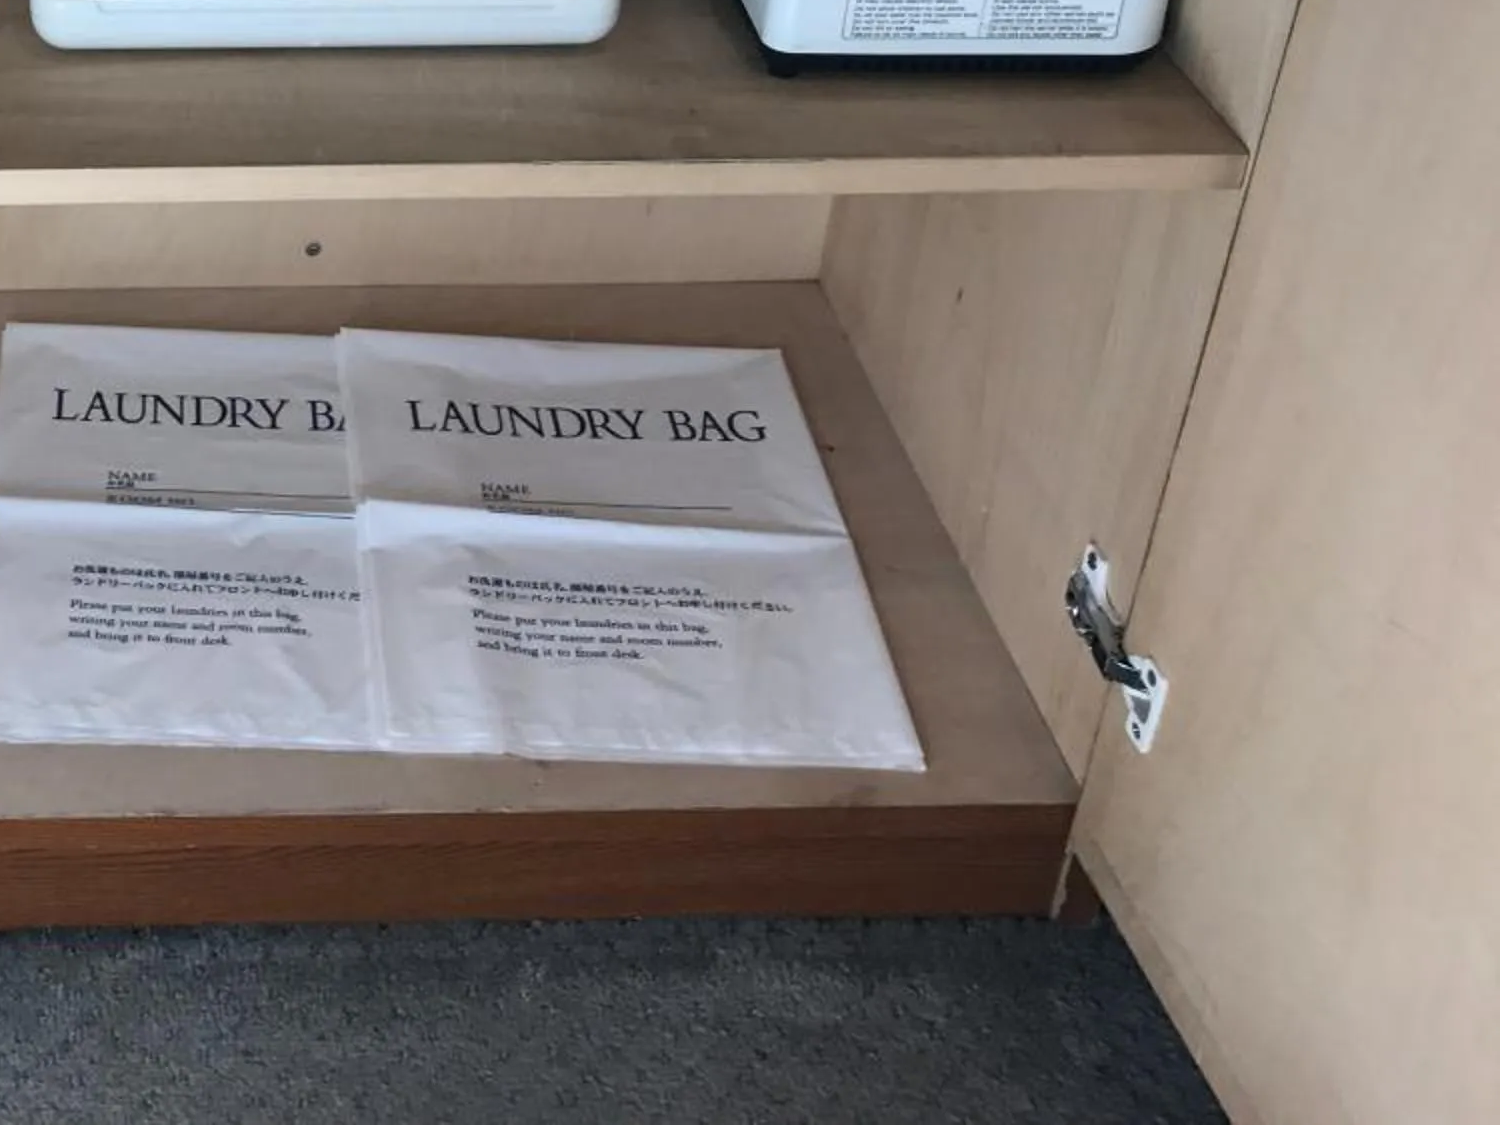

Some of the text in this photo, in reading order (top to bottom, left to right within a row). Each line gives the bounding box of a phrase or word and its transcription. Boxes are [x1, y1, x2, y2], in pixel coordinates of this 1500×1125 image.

[52, 388, 347, 432] LAUNDRY B
[405, 400, 767, 442] LAUNDRY BAG
[108, 470, 158, 482] NAME
[481, 482, 530, 494] NAME
[70, 598, 108, 610] Please
[112, 604, 132, 614] put
[138, 605, 166, 615] your
[69, 615, 116, 627] writing
[120, 619, 149, 629] your
[153, 621, 187, 630] name
[191, 621, 215, 632] and
[218, 623, 253, 633] room
[473, 608, 511, 621] Please
[515, 616, 537, 627] put
[540, 617, 572, 627] your
[68, 629, 91, 639] and
[95, 629, 129, 644] bring
[475, 626, 522, 640] writing
[525, 632, 555, 642] your
[560, 634, 596, 643] name
[599, 634, 623, 644] and
[627, 638, 663, 646] room
[477, 640, 501, 651] and
[503, 642, 539, 657] bring
